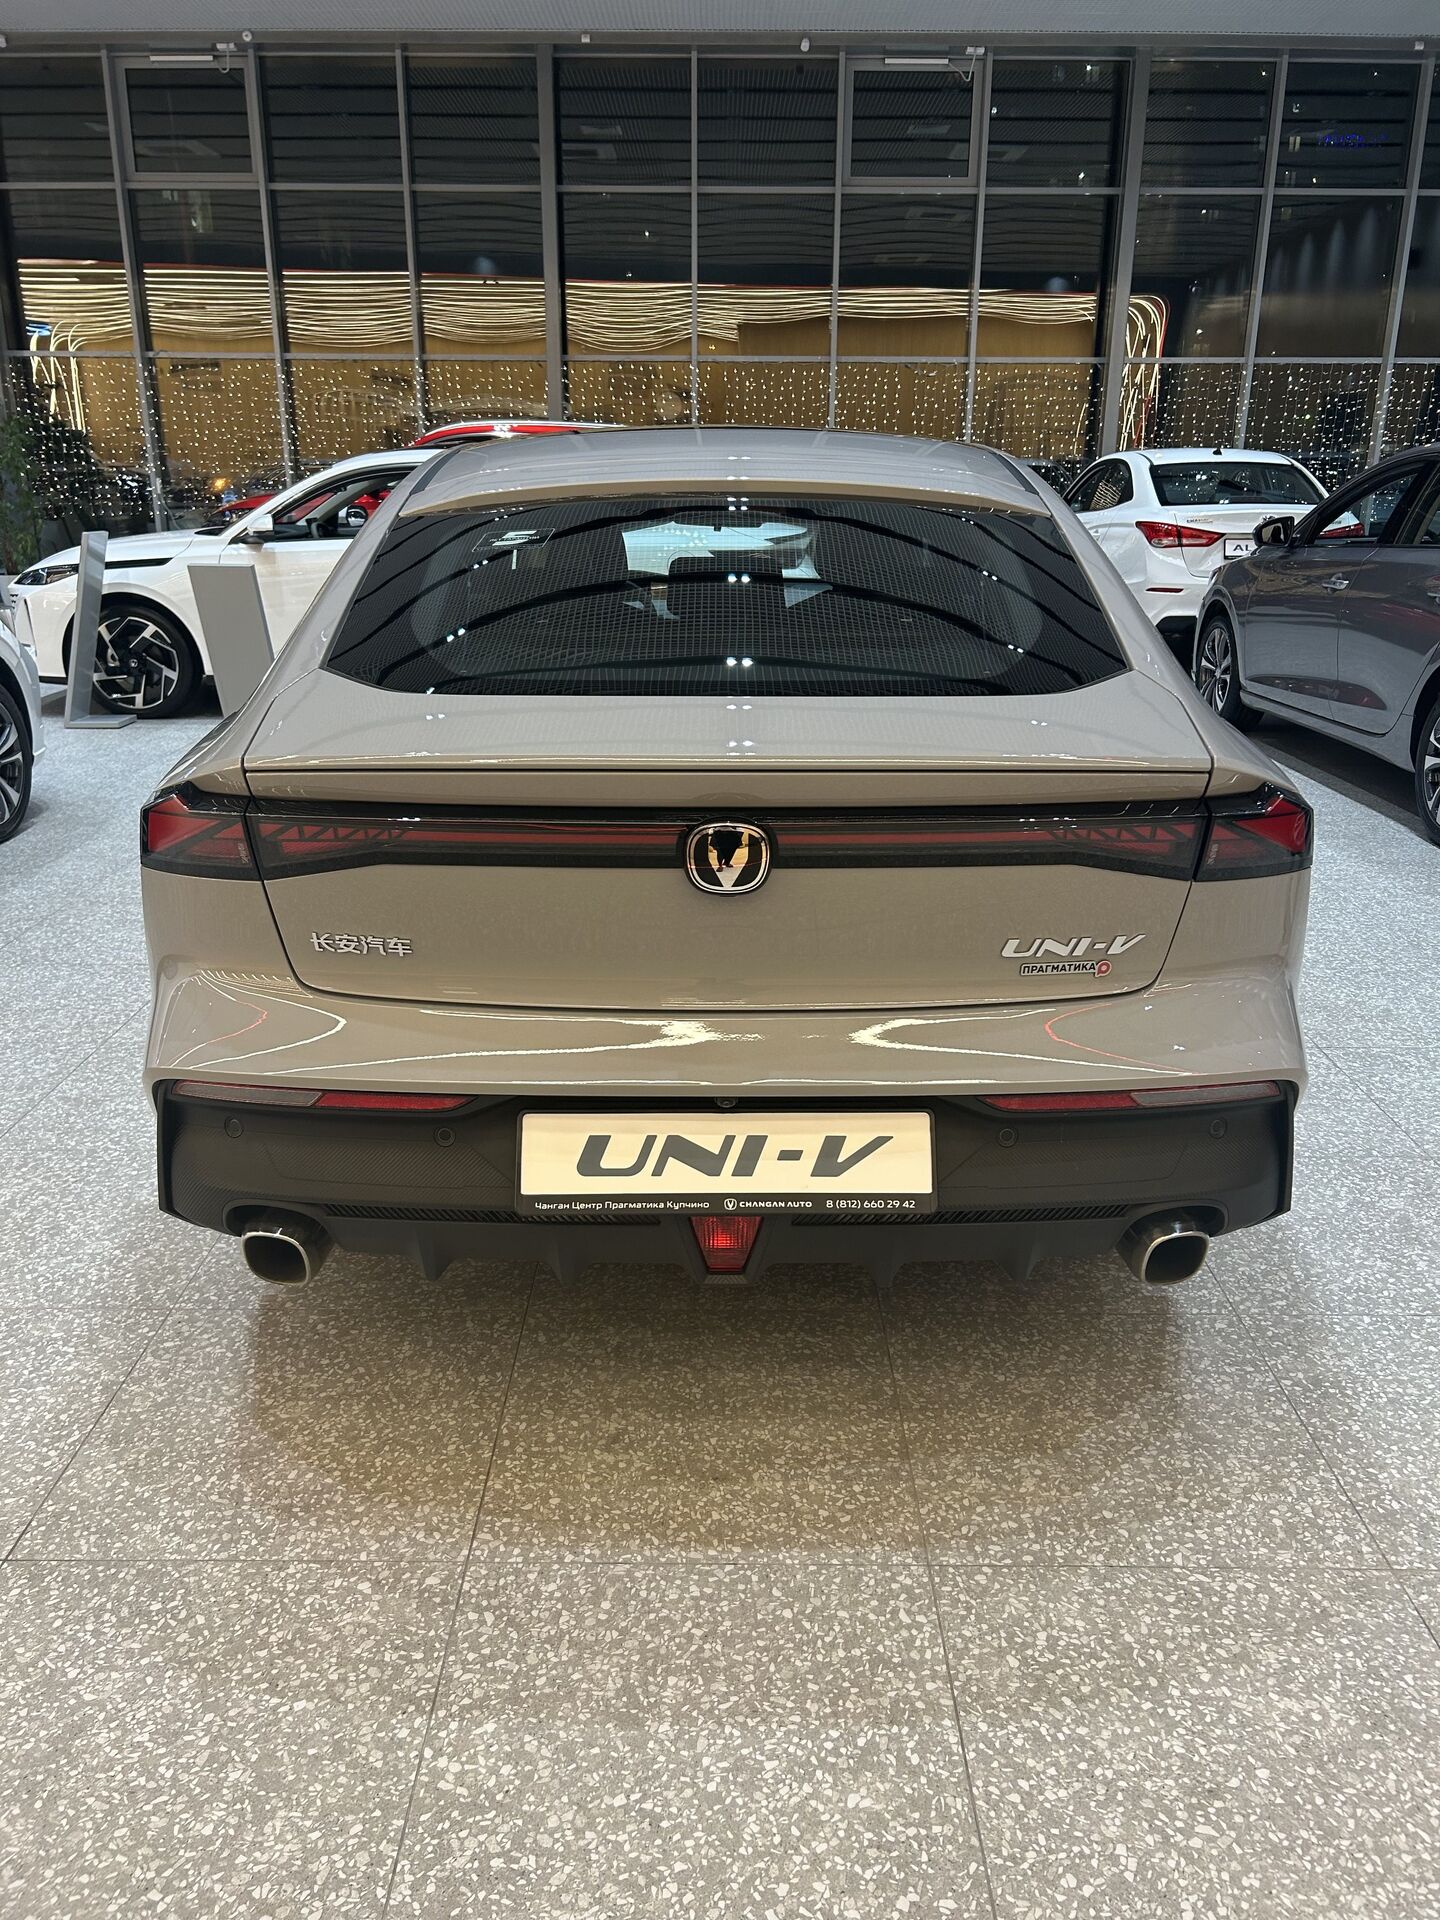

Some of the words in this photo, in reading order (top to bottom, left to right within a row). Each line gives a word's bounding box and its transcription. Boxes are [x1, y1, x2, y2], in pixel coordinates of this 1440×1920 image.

[309, 932, 413, 957] 长安汽车
[1001, 934, 1146, 958] UNI-V
[1022, 962, 1096, 974] ПРАГМАТИКА
[576, 1134, 894, 1178] UNI-V
[534, 1202, 570, 1210] Чанган
[571, 1201, 603, 1211] Центр
[604, 1201, 665, 1210] Прагматика
[666, 1200, 710, 1210] Купчино
[825, 1200, 833, 1209] 8
[835, 1199, 861, 1210] (812)
[863, 1200, 885, 1209] 660
[886, 1200, 900, 1209] 29
[902, 1200, 916, 1209] 42
